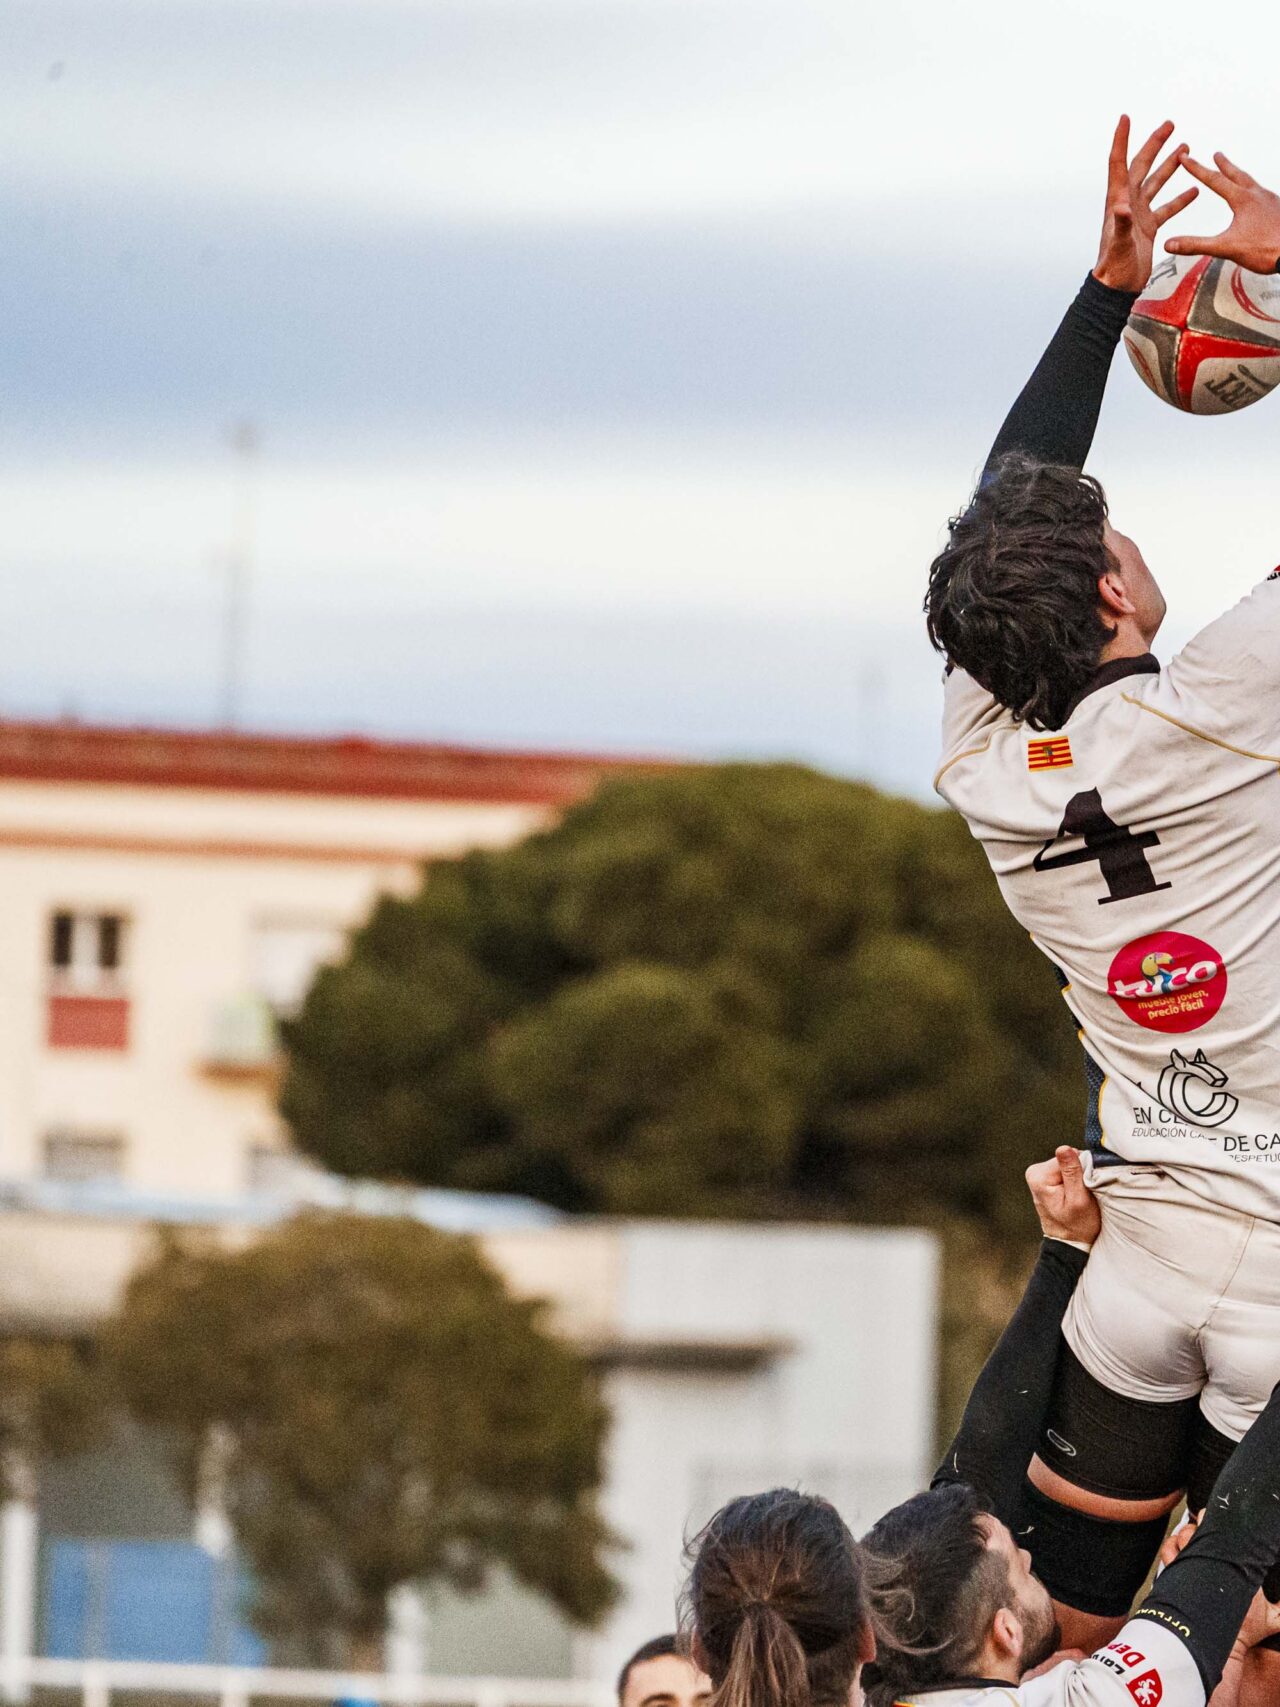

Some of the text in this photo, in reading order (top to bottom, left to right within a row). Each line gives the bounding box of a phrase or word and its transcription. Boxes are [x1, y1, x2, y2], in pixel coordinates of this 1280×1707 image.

[1033, 786, 1172, 905] 4
[1138, 989, 1209, 1009] mueble joven,
[1147, 998, 1205, 1020] precio fácil
[1131, 1126, 1187, 1138] EDUCACIÓN
[1133, 1106, 1152, 1124] EN
[1223, 1135, 1250, 1152] DE
